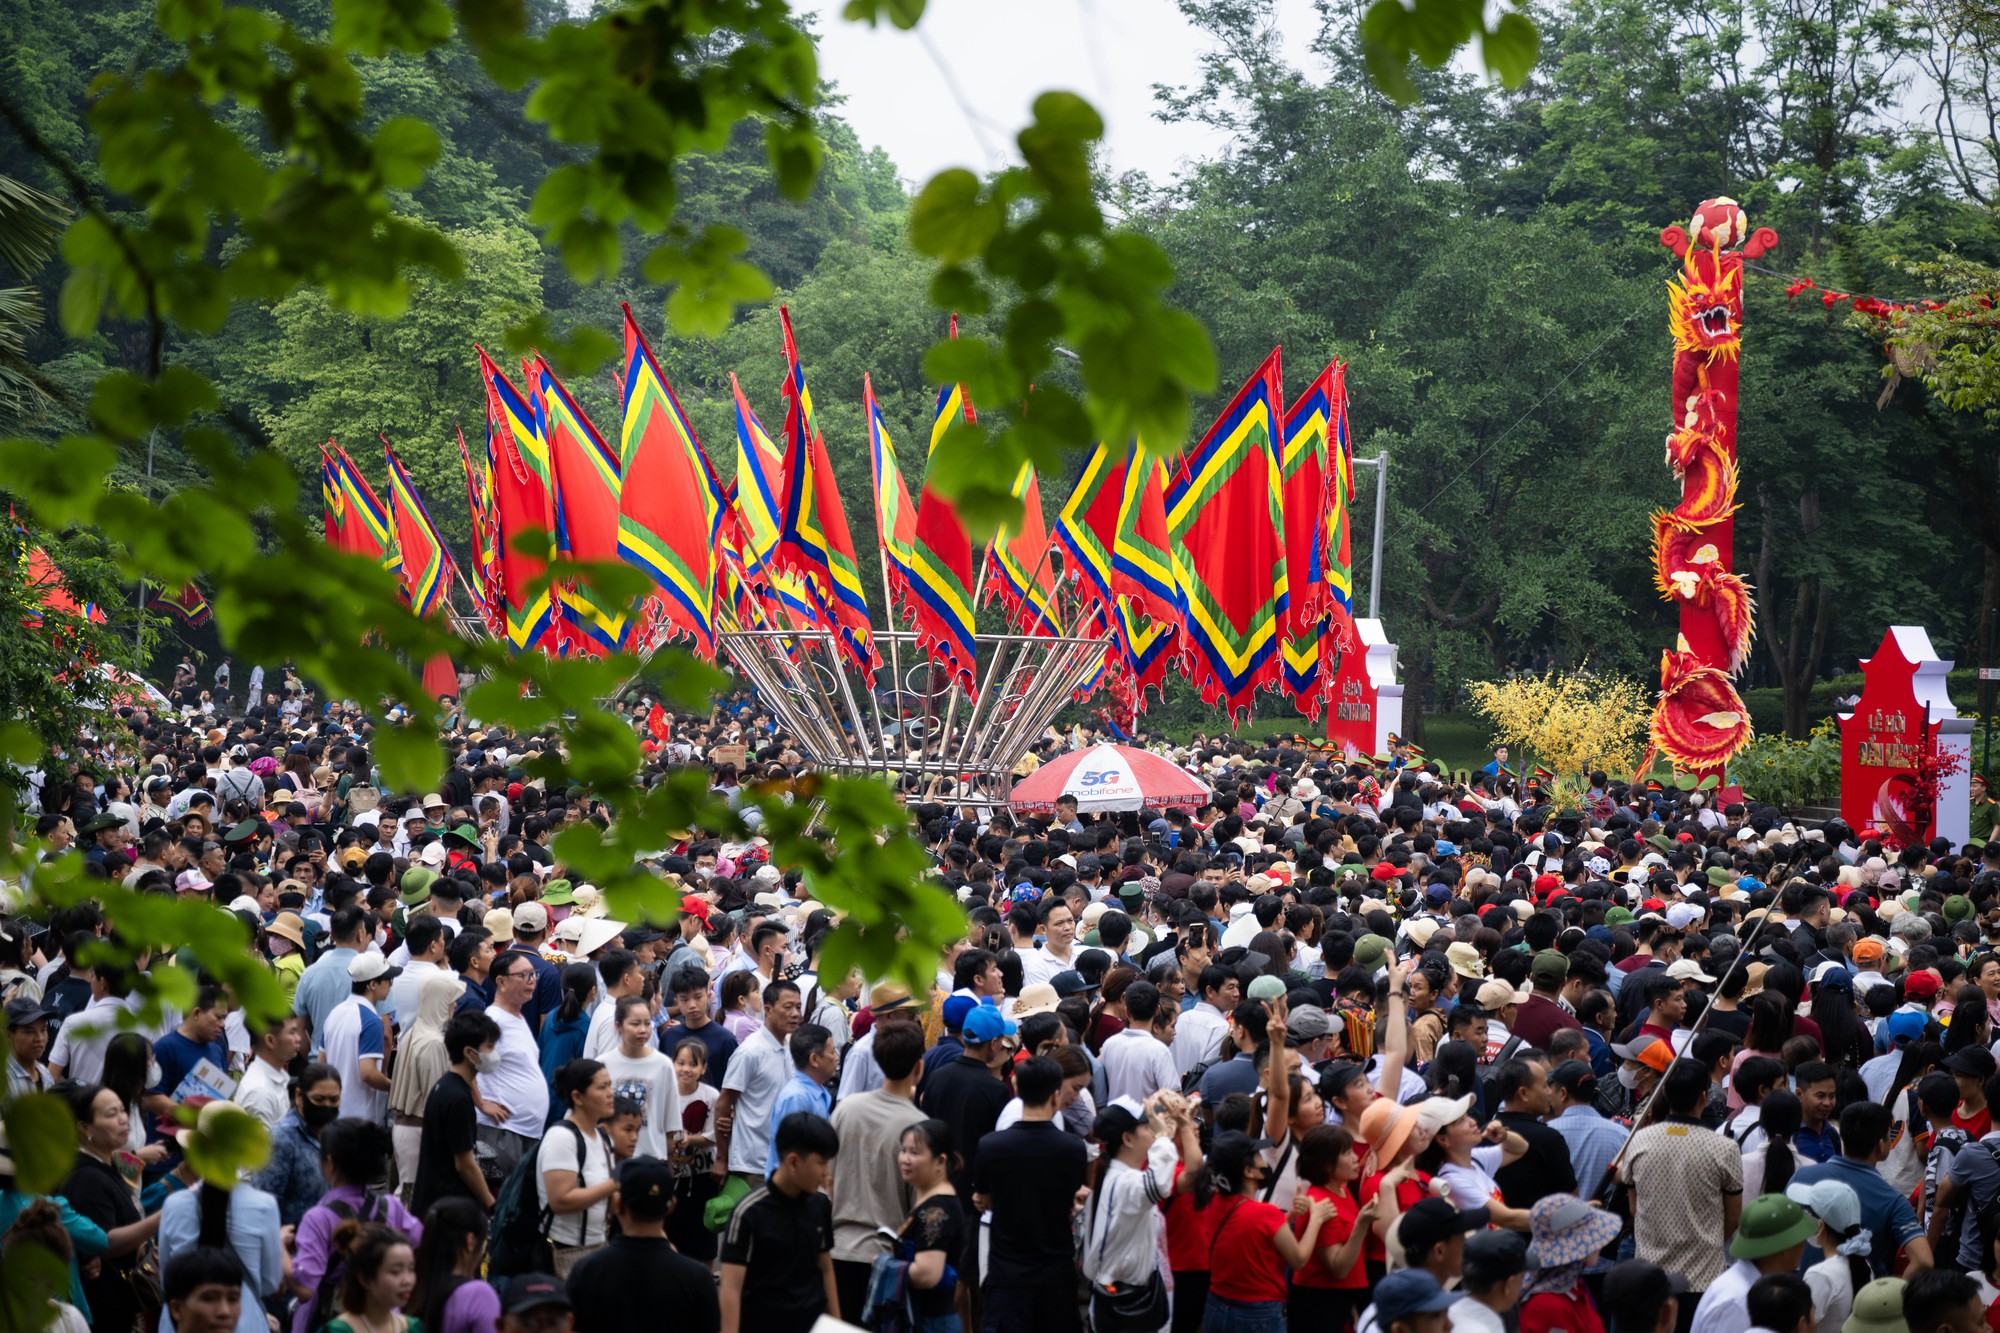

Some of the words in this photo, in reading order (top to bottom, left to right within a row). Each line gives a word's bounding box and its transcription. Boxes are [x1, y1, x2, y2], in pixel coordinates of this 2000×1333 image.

[1868, 708, 1882, 732] LỄ
[1080, 770, 1120, 786] 5G
[1065, 787, 1134, 797] mobifone
